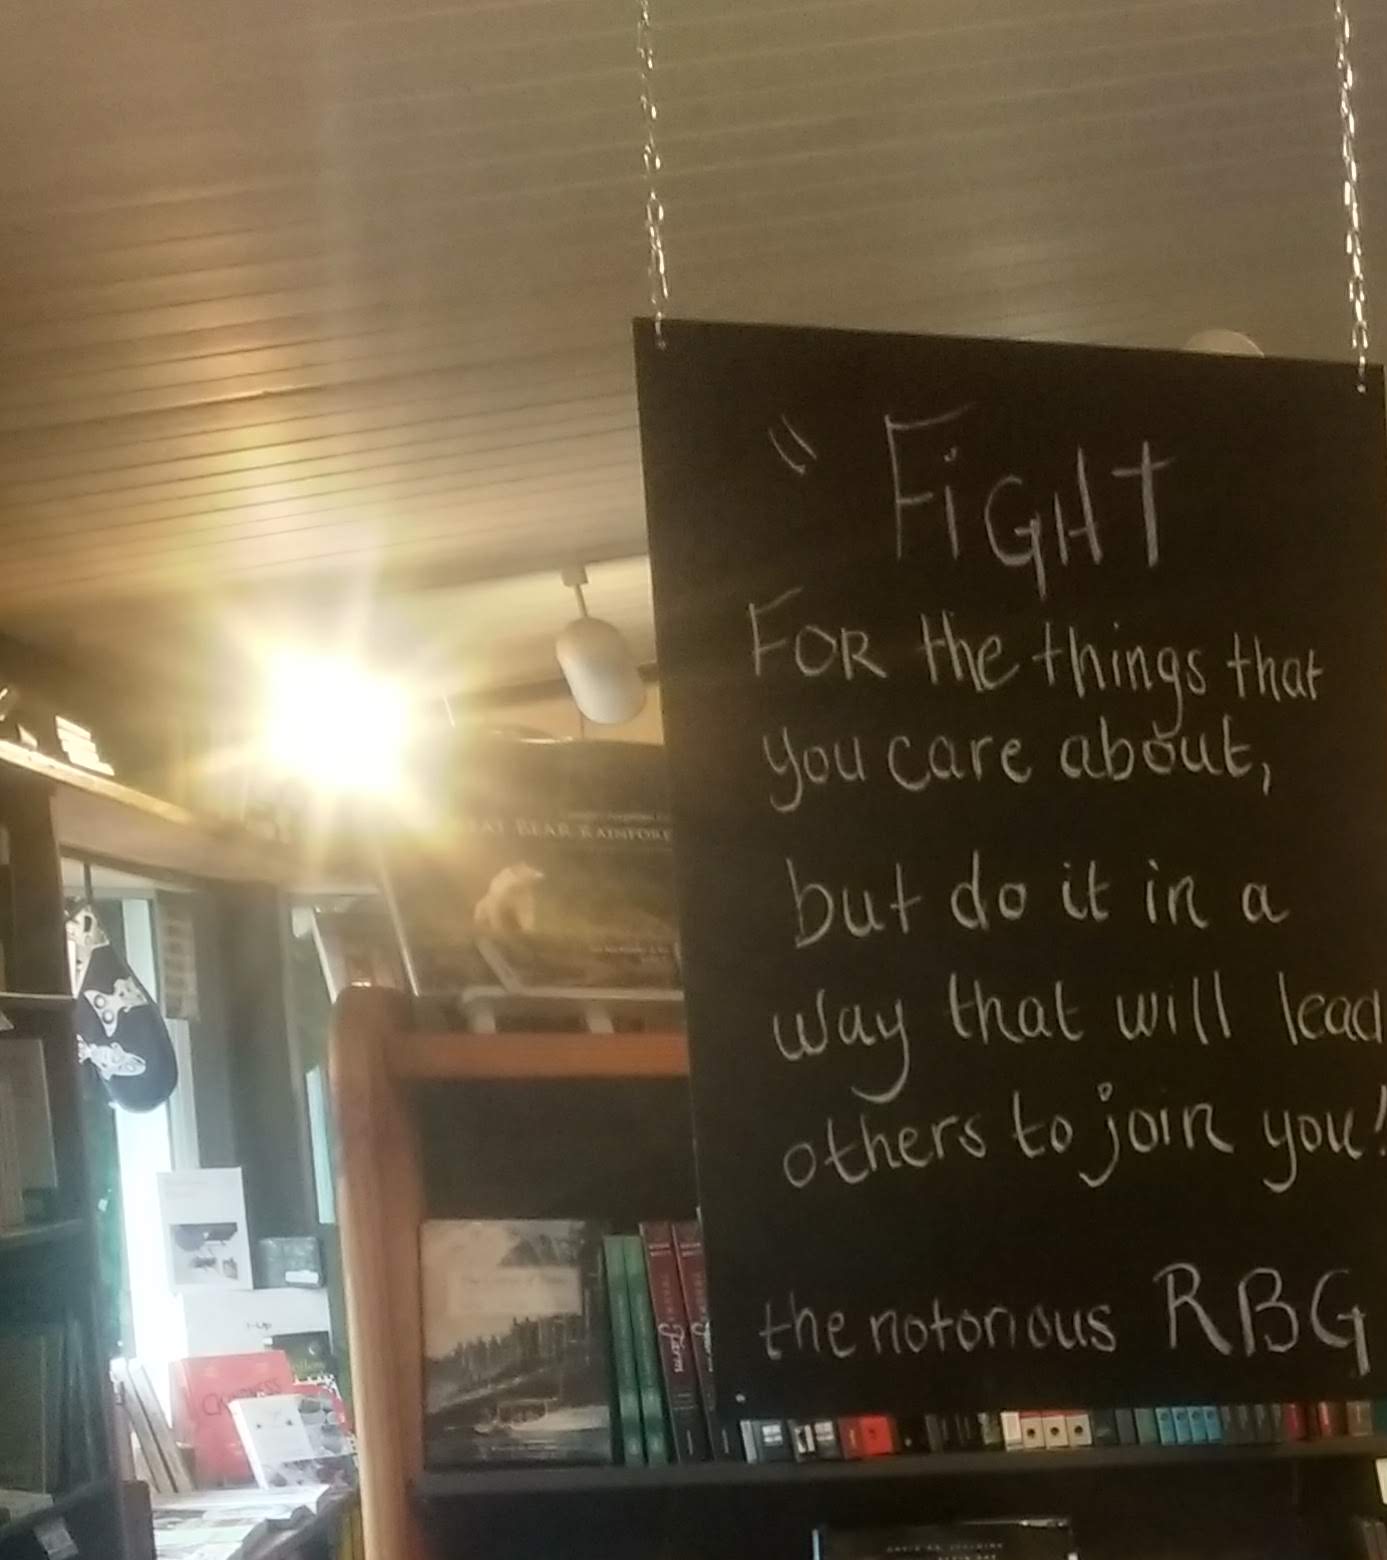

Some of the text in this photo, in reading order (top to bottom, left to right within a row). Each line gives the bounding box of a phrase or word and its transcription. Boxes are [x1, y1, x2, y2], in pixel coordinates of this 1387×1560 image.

[920, 609, 1021, 691] the
[1032, 622, 1207, 734] things
[1225, 635, 1323, 702] that
[762, 715, 1274, 812] you care about,
[786, 852, 1290, 949] but do it in a
[772, 973, 1384, 1103] way that will lead
[783, 1112, 987, 1189] others
[1011, 1103, 1074, 1159] to
[1077, 1080, 1237, 1187] join
[759, 1259, 1367, 1376] the notorious RBG
